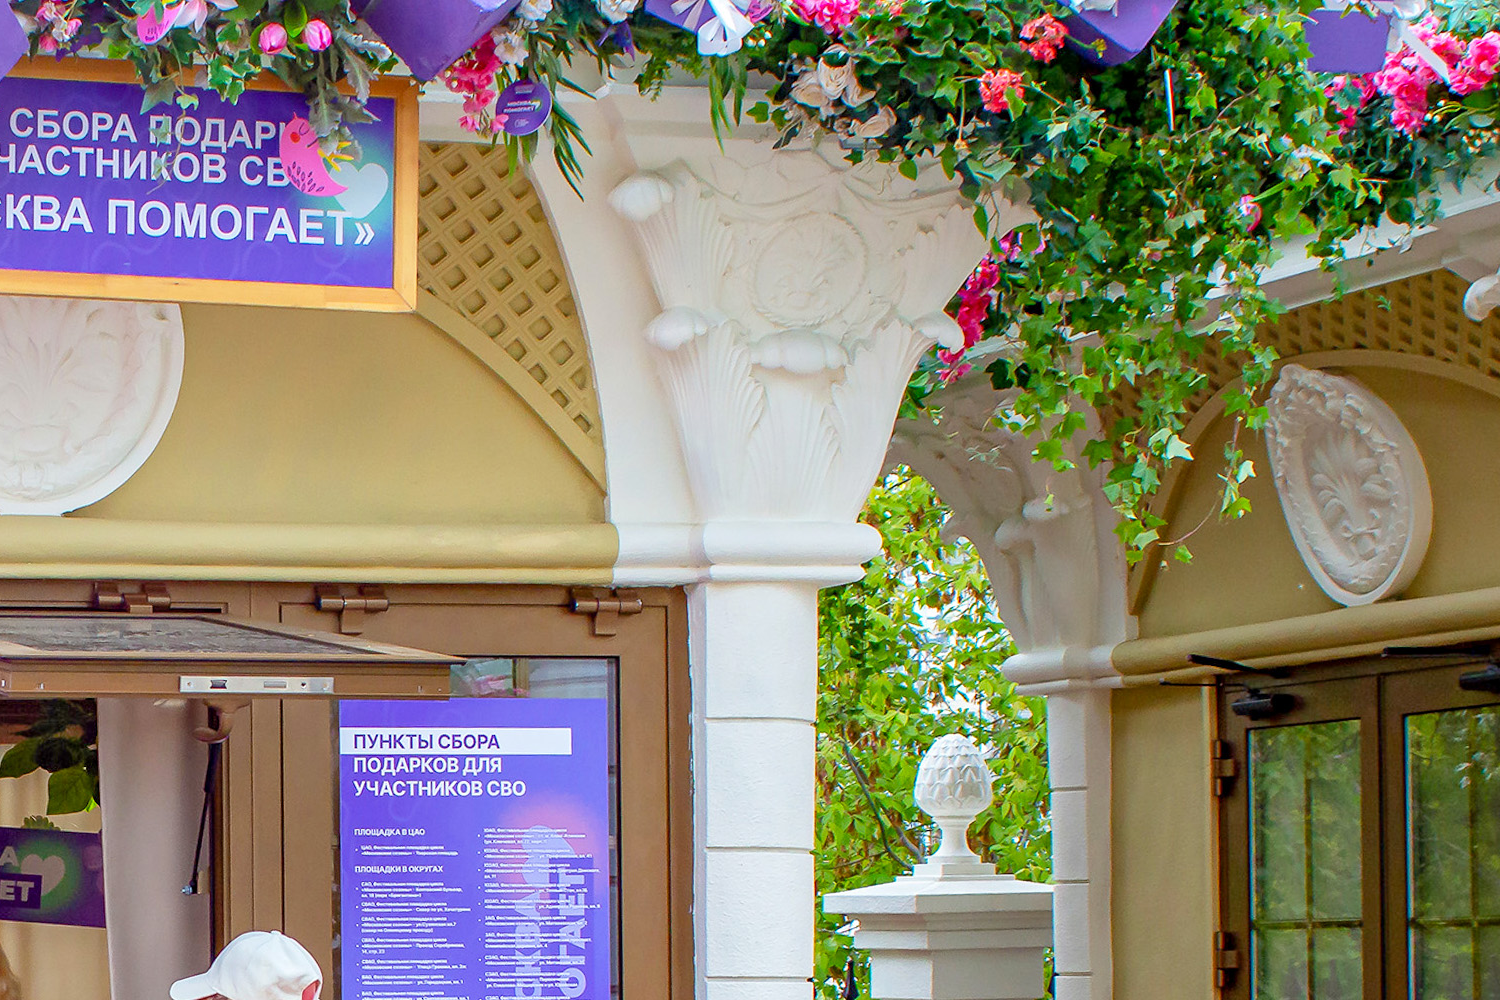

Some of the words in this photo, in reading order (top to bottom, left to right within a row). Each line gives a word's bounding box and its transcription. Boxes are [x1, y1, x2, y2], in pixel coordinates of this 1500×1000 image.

[9, 107, 138, 144] СБОРА
[149, 114, 286, 153] ПОДАР
[239, 154, 291, 187] СВ
[106, 198, 376, 246] ПОМОГАЕТ»
[353, 734, 434, 750] ПУНКТЫ
[437, 734, 500, 750] СБОРА
[353, 757, 459, 776] ПОДАРКОВ
[463, 757, 502, 775] ДЛЯ
[353, 780, 483, 797] УЧАСТНИКОВ
[486, 780, 526, 797] СВО
[354, 828, 401, 838] ПЛОЩАДКА
[402, 828, 407, 836] В
[408, 828, 426, 837] ЦАО
[354, 865, 401, 874] ПЛОЩАДКИ
[402, 865, 407, 873] В
[408, 865, 444, 873] ОКРУГАХ
